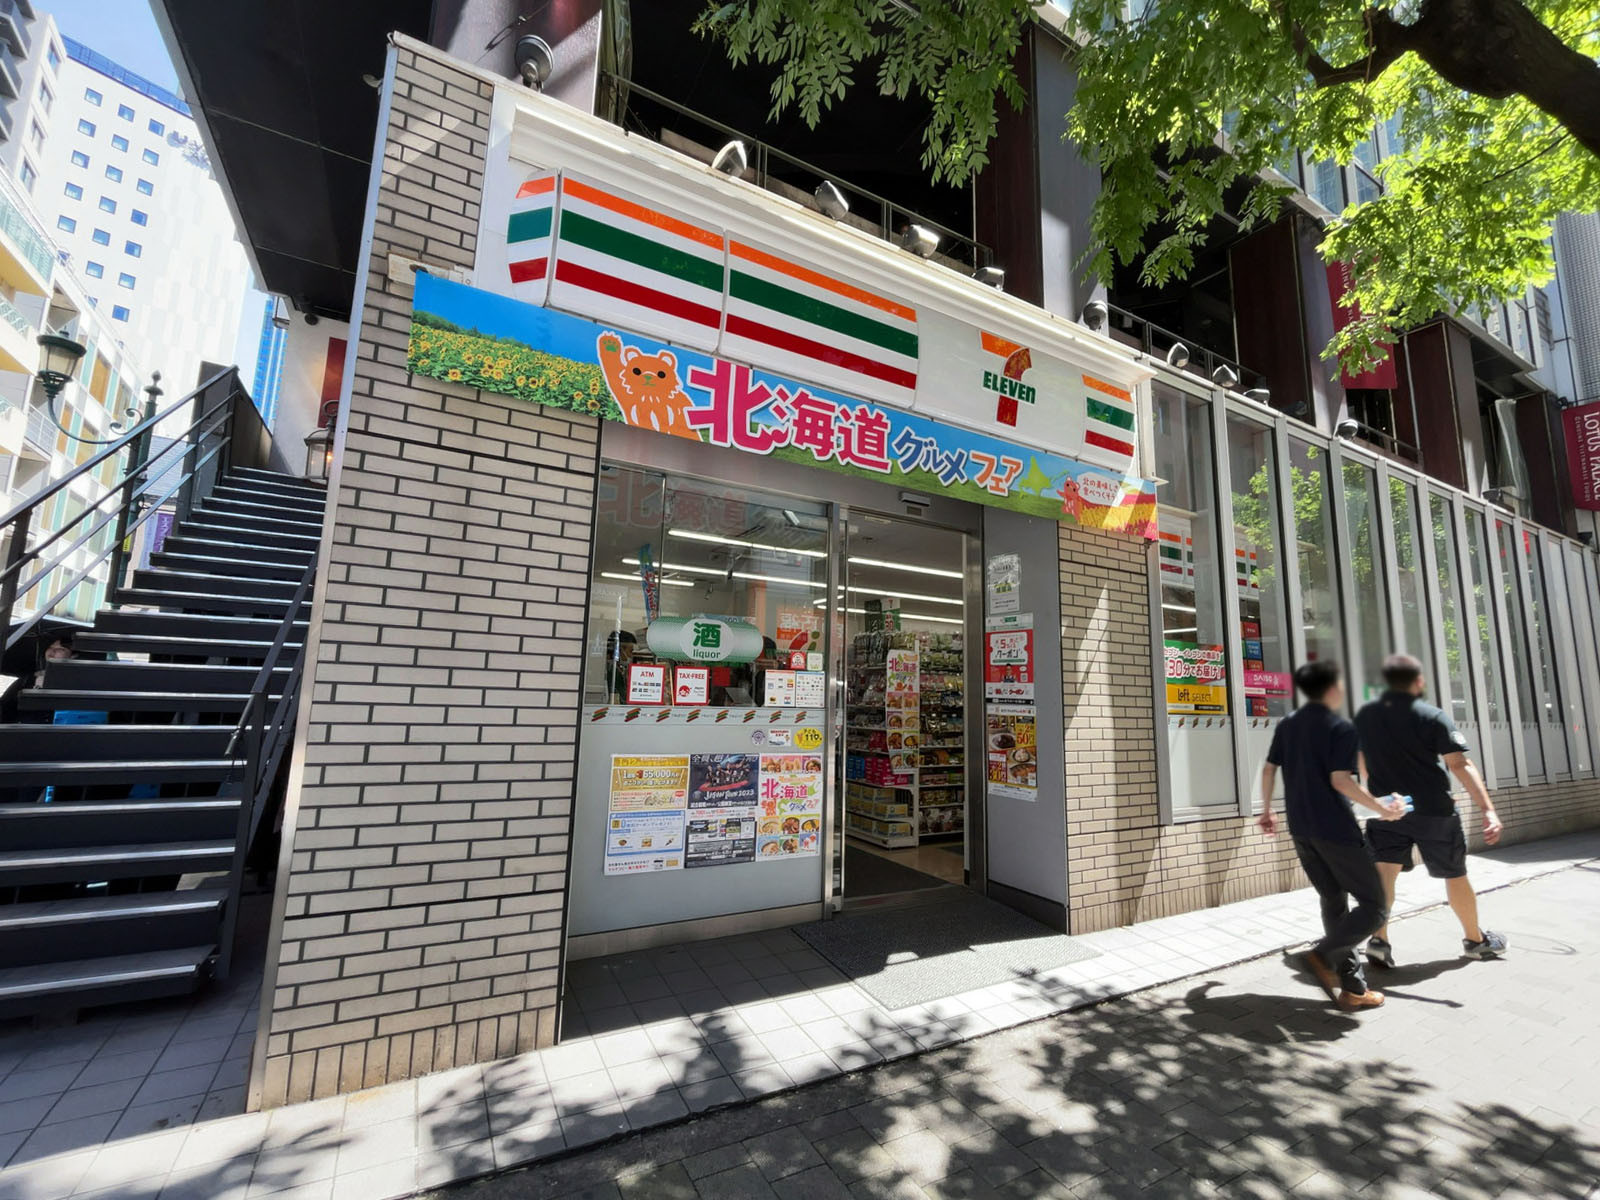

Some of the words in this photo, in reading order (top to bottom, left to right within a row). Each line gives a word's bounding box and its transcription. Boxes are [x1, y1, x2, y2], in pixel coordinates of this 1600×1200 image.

[1584, 411, 1600, 452] LOTUS
[693, 622, 721, 648] 酒
[693, 649, 721, 659] liquor
[888, 658, 916, 672] 北海道
[1165, 659, 1221, 678] 30分でお届け！
[1253, 674, 1272, 682] DAISO
[1192, 693, 1211, 702] SELECT
[761, 778, 808, 799] 北海道
